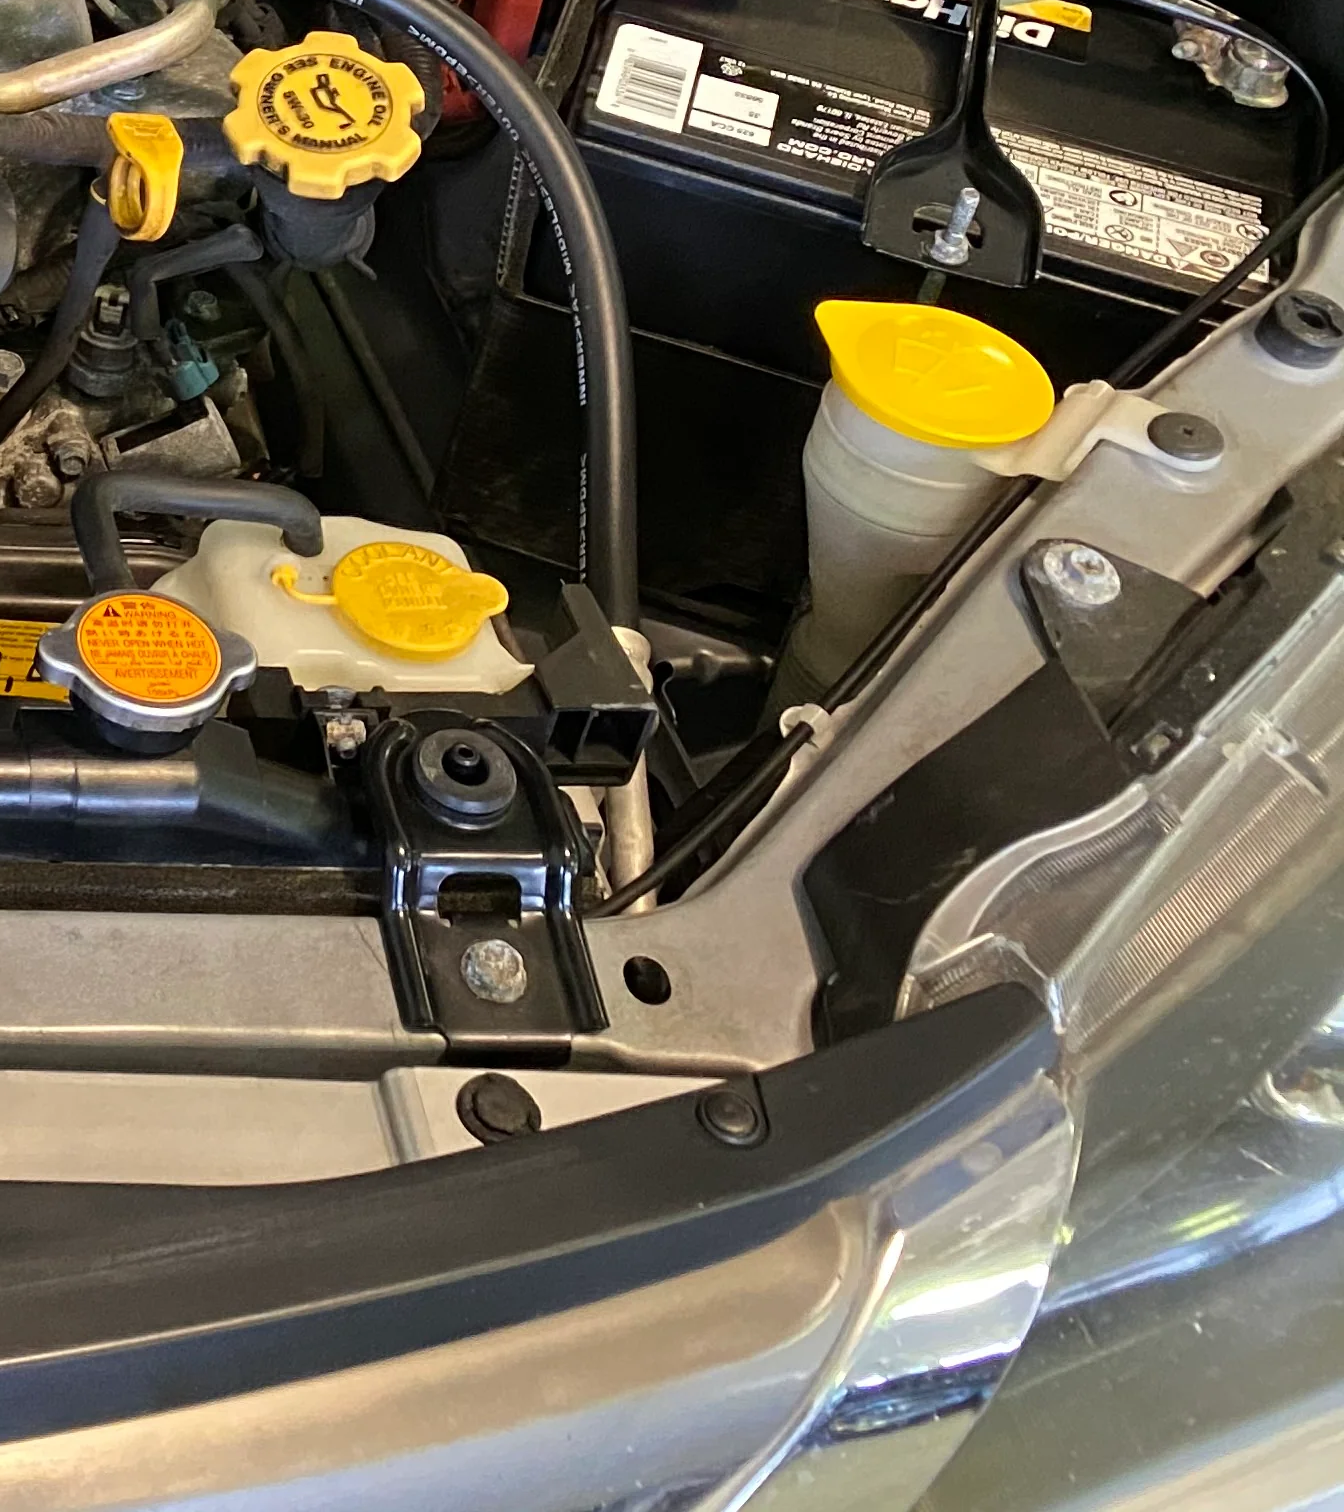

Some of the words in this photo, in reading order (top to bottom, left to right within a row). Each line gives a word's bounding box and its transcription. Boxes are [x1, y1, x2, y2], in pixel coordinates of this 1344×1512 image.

[283, 56, 318, 75] SEE
[329, 57, 386, 101] ENGINE
[367, 104, 387, 127] OIL
[709, 119, 735, 132] CCA
[291, 133, 369, 149] MANUAL
[123, 610, 177, 619] WARNING
[87, 639, 120, 647] NEVER
[122, 639, 151, 648] OPEN
[152, 639, 184, 648] WHEN
[114, 668, 199, 680] AVERTISSEMENT
